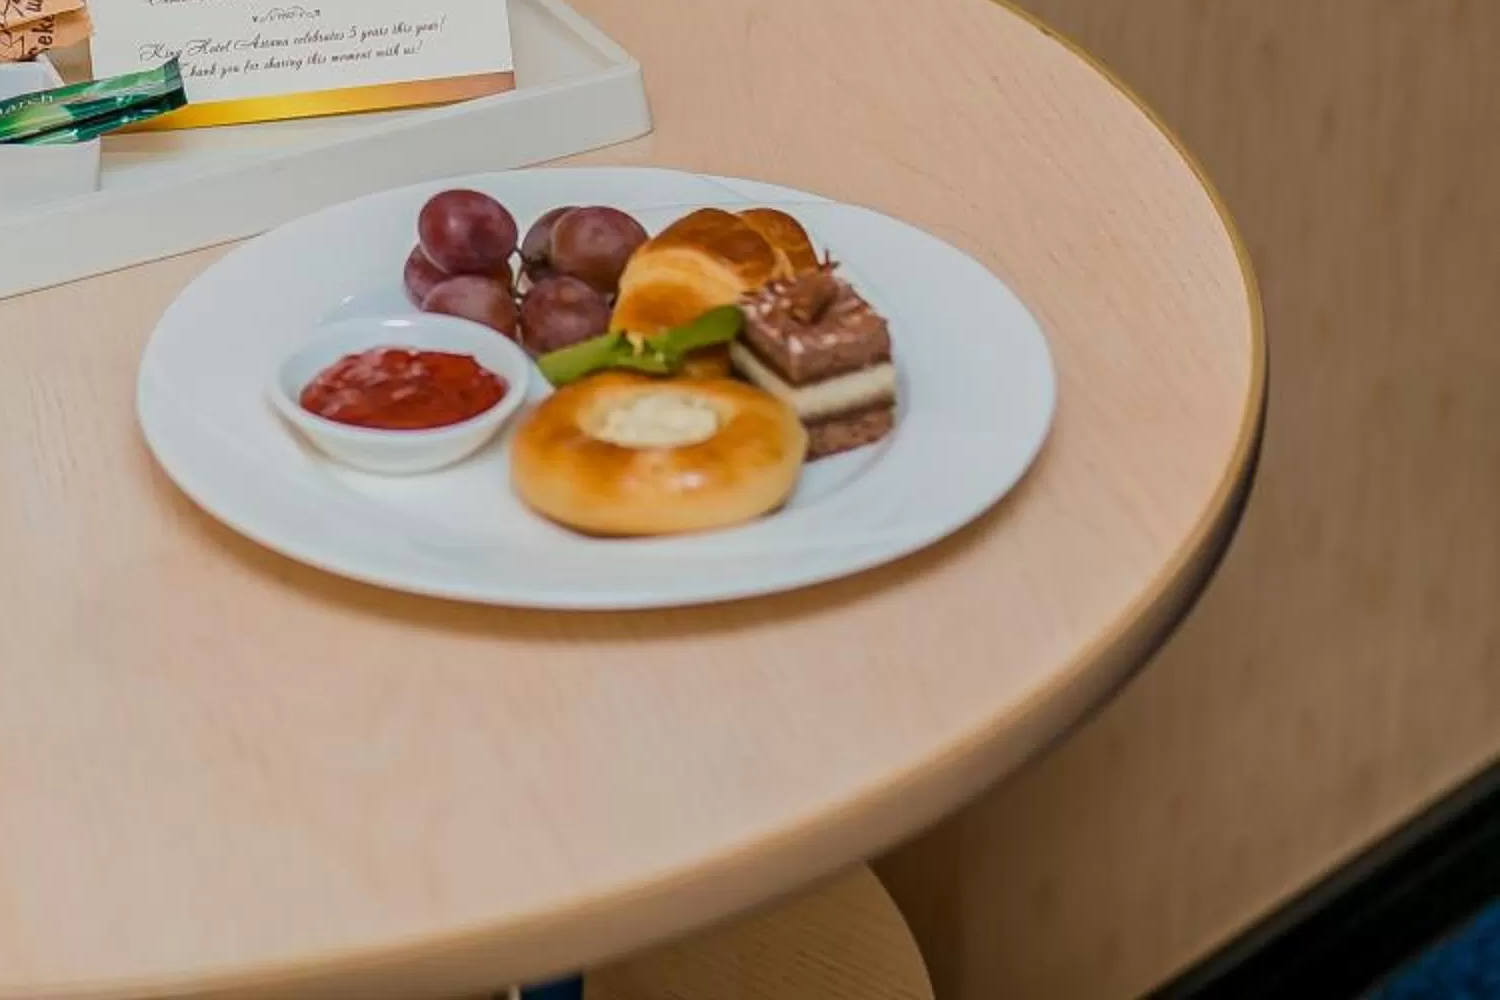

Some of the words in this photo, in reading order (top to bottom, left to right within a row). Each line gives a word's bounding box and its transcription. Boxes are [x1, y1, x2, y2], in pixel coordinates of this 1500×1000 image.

[140, 43, 182, 60] King
[186, 39, 232, 57] Hotel
[234, 32, 289, 50] Astana
[293, 29, 345, 46] celebrates
[348, 26, 357, 40] 5
[360, 24, 389, 42] years
[391, 21, 412, 36] this
[415, 15, 445, 36] year!
[220, 64, 240, 80] you
[244, 57, 260, 74] for
[263, 53, 303, 71] sharing
[306, 50, 326, 66] this
[331, 49, 371, 64] moment
[375, 43, 399, 58] with
[403, 38, 424, 56] us!
